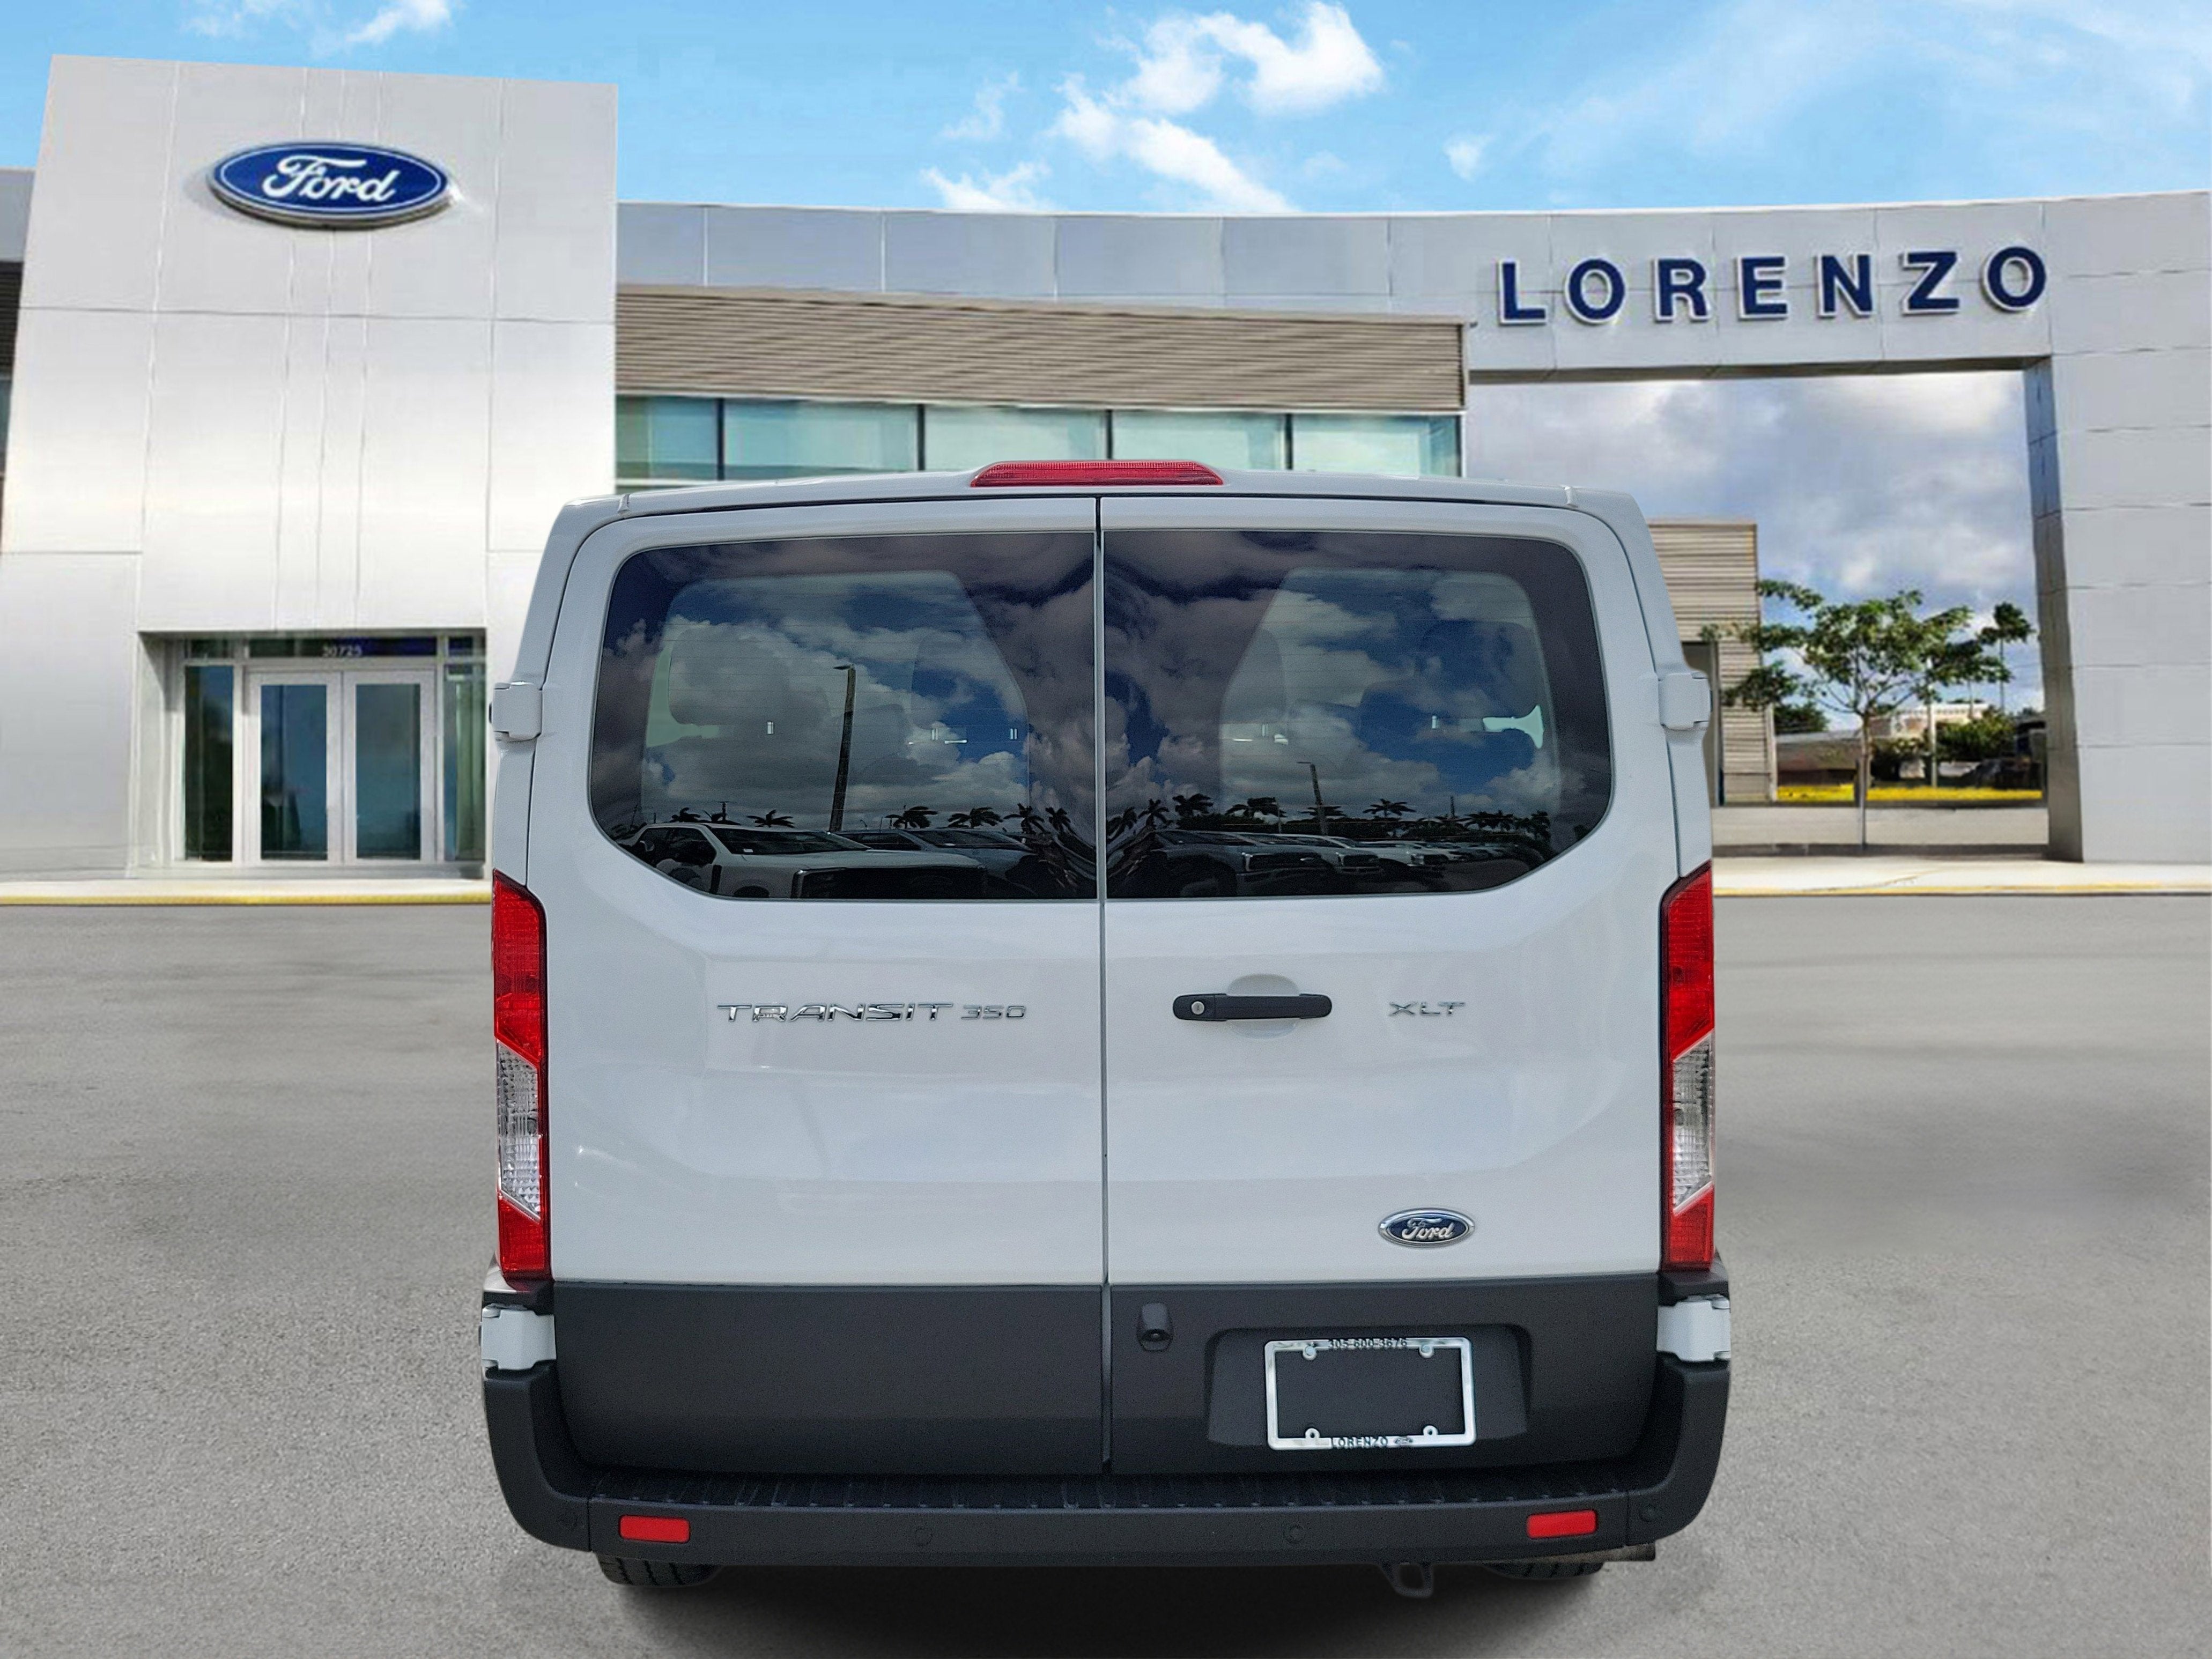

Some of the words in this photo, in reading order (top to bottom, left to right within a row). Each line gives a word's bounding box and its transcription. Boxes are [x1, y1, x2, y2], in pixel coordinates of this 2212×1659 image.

[263, 154, 400, 202] Ford
[1497, 245, 2047, 325] LORENZO
[717, 1002, 953, 1022] TRANSIT
[960, 1004, 1027, 1020] 350
[1388, 1001, 1465, 1017] XLT
[1401, 1217, 1455, 1240] Ford
[1331, 1435, 1388, 1449] LORENZO
